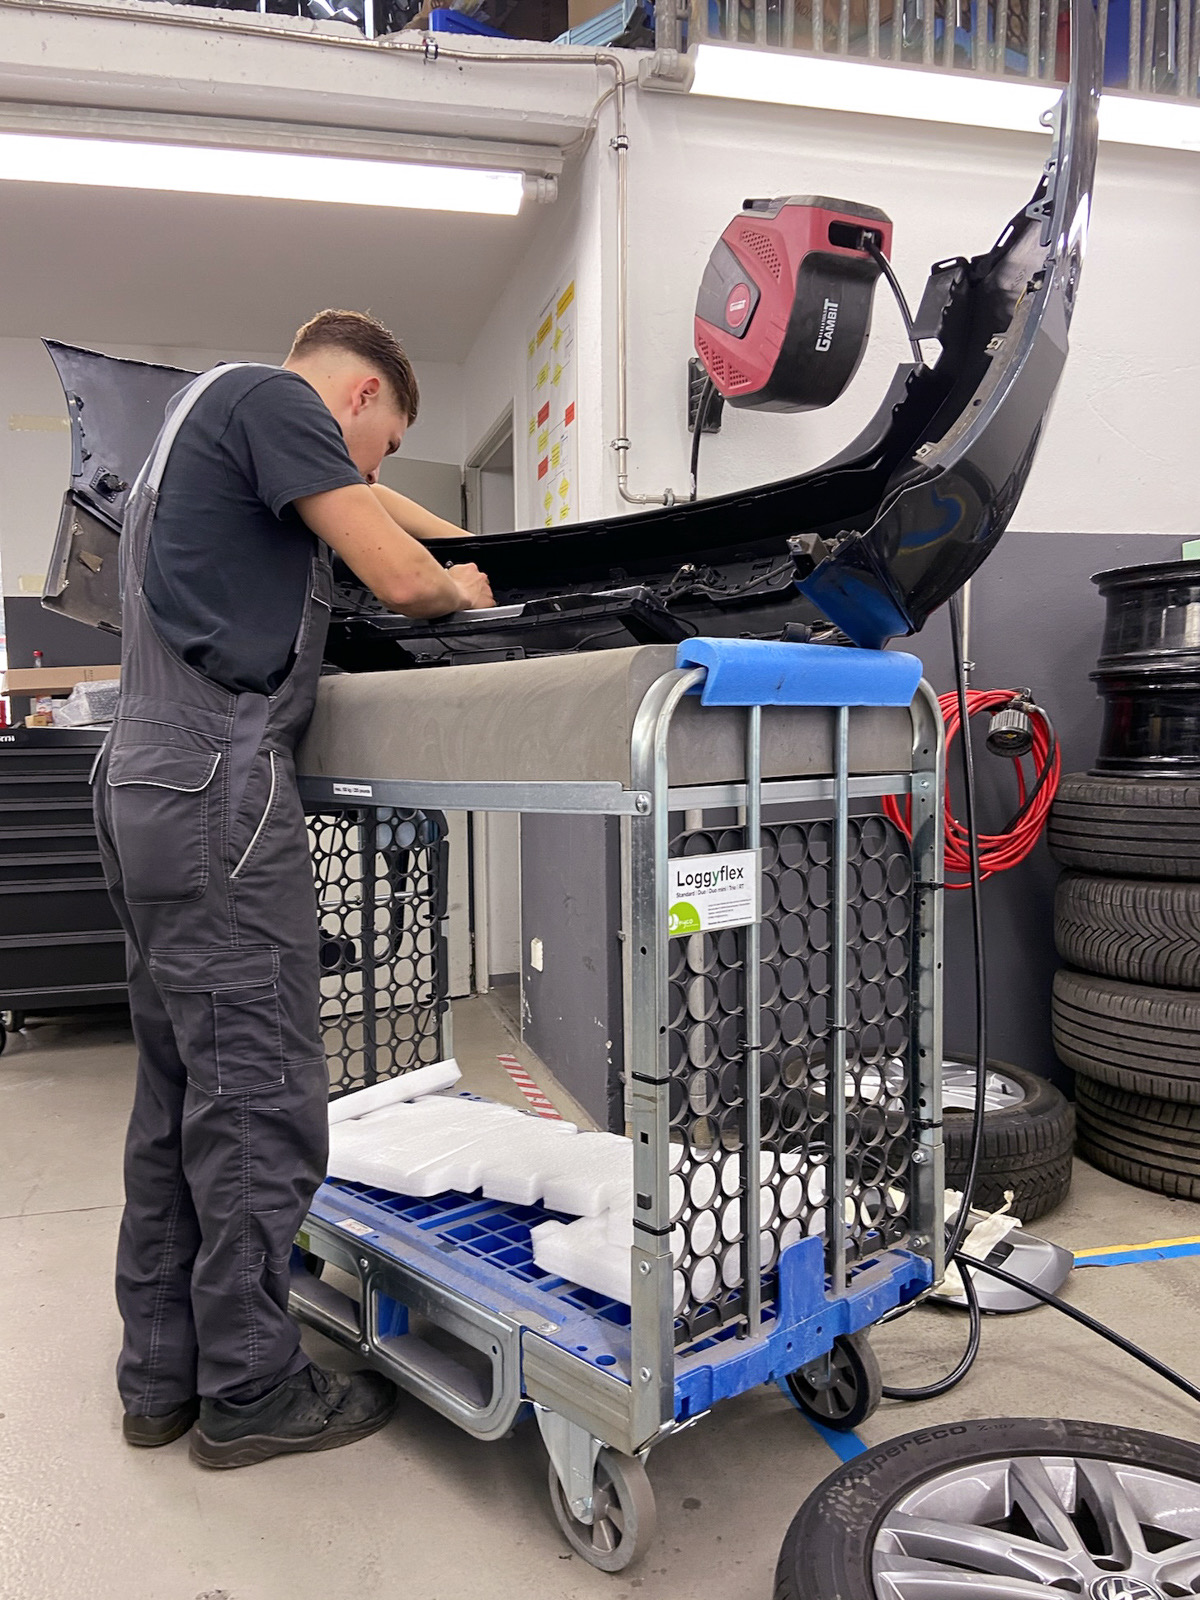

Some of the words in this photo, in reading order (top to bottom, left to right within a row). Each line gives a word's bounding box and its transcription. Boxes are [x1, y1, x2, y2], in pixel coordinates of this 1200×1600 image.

[815, 298, 839, 352] GAMBIT
[677, 865, 744, 889] Loggyflex
[676, 890, 695, 898] Standard
